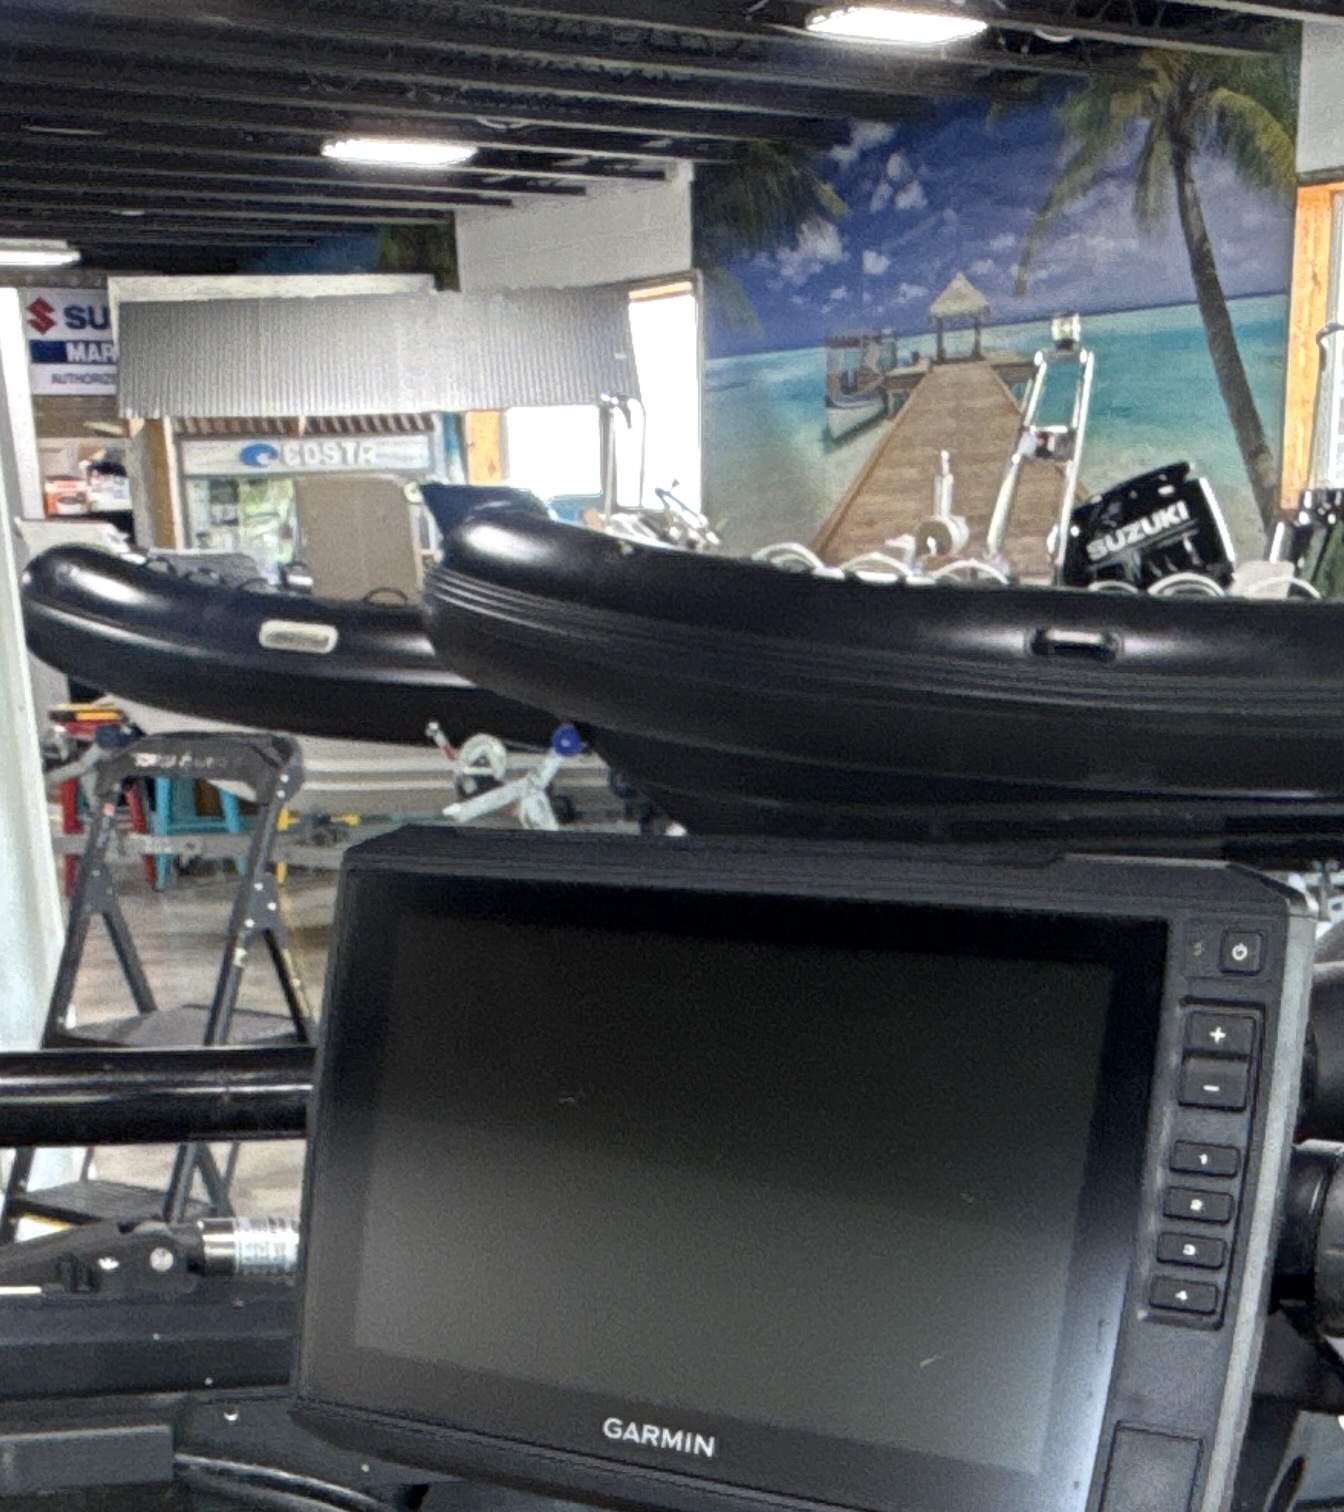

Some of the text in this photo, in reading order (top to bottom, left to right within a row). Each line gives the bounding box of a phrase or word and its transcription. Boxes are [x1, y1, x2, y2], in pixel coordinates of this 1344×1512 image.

[63, 304, 111, 330] SU
[282, 441, 377, 467] COSTA
[1086, 500, 1190, 561] SUZUKI
[602, 1416, 716, 1458] GARMIN
